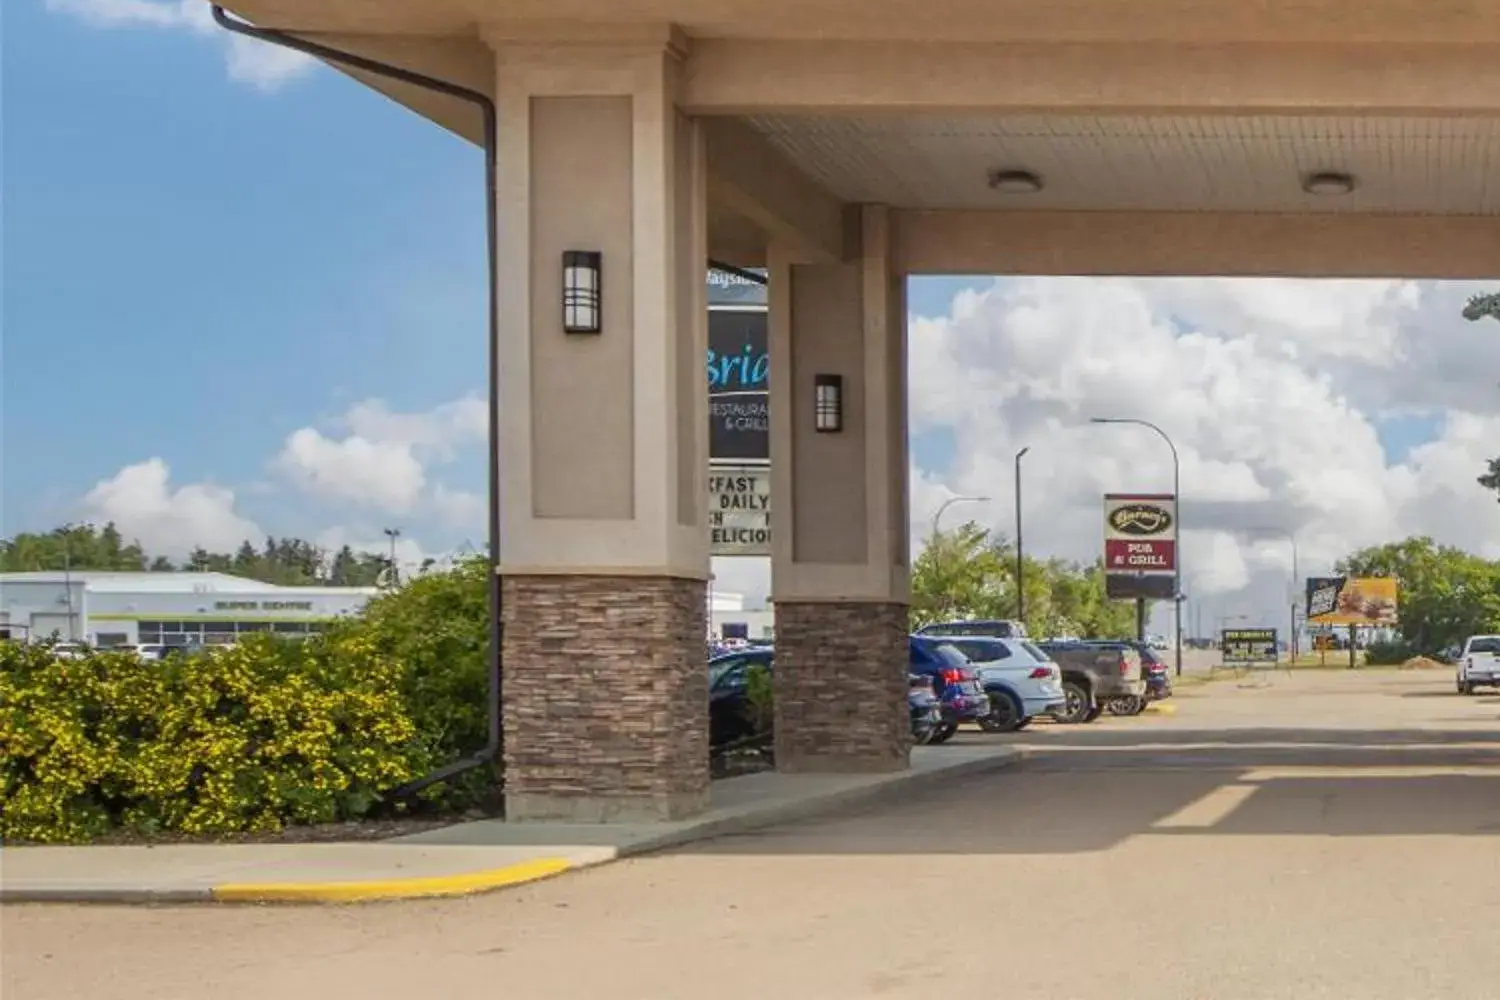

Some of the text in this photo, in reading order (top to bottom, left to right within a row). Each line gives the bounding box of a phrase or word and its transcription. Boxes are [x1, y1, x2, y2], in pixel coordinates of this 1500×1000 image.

[720, 494, 768, 509] DAILY
[1128, 543, 1153, 553] PUB
[1128, 555, 1167, 565] GRILL
